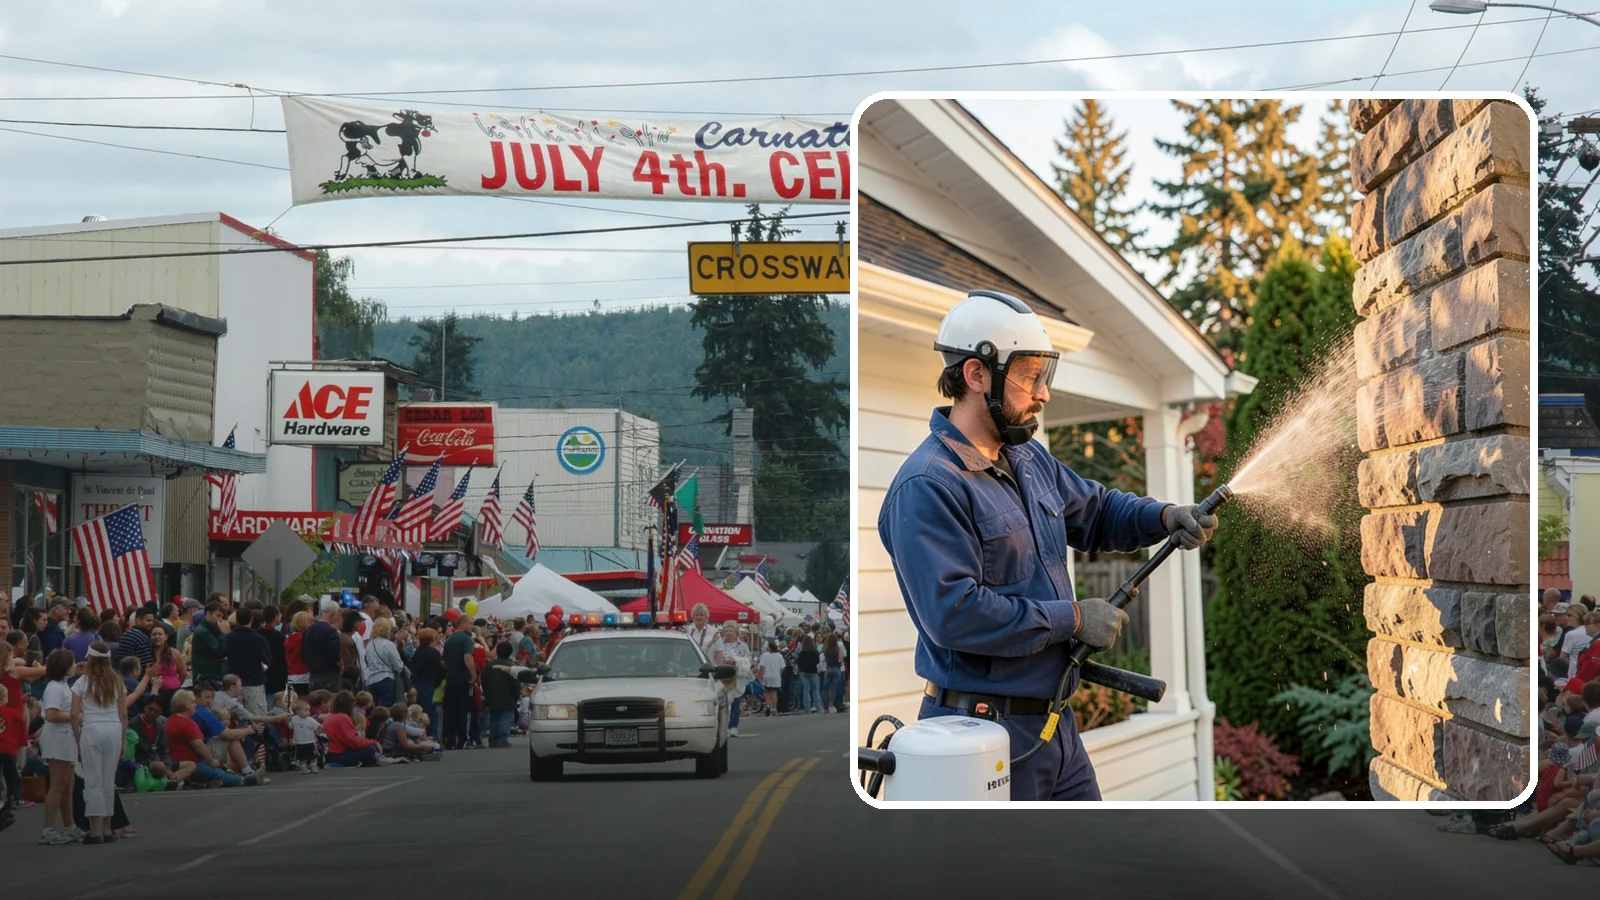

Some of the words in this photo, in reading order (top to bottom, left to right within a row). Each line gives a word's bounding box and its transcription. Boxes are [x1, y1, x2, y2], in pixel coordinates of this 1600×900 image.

[481, 141, 605, 192] JULY
[632, 150, 746, 198] 4th.
[697, 254, 850, 280] CROSSWA
[283, 380, 374, 420] ACE
[405, 409, 452, 422] CEDAR
[284, 421, 371, 437] Hardware
[416, 428, 477, 447] Coca-Cola
[354, 467, 384, 480] Simpl
[95, 484, 124, 495] Vincent
[126, 486, 136, 495] de
[137, 486, 155, 496] Paul
[688, 526, 741, 535] CRNATION
[699, 535, 730, 543] GLASS
